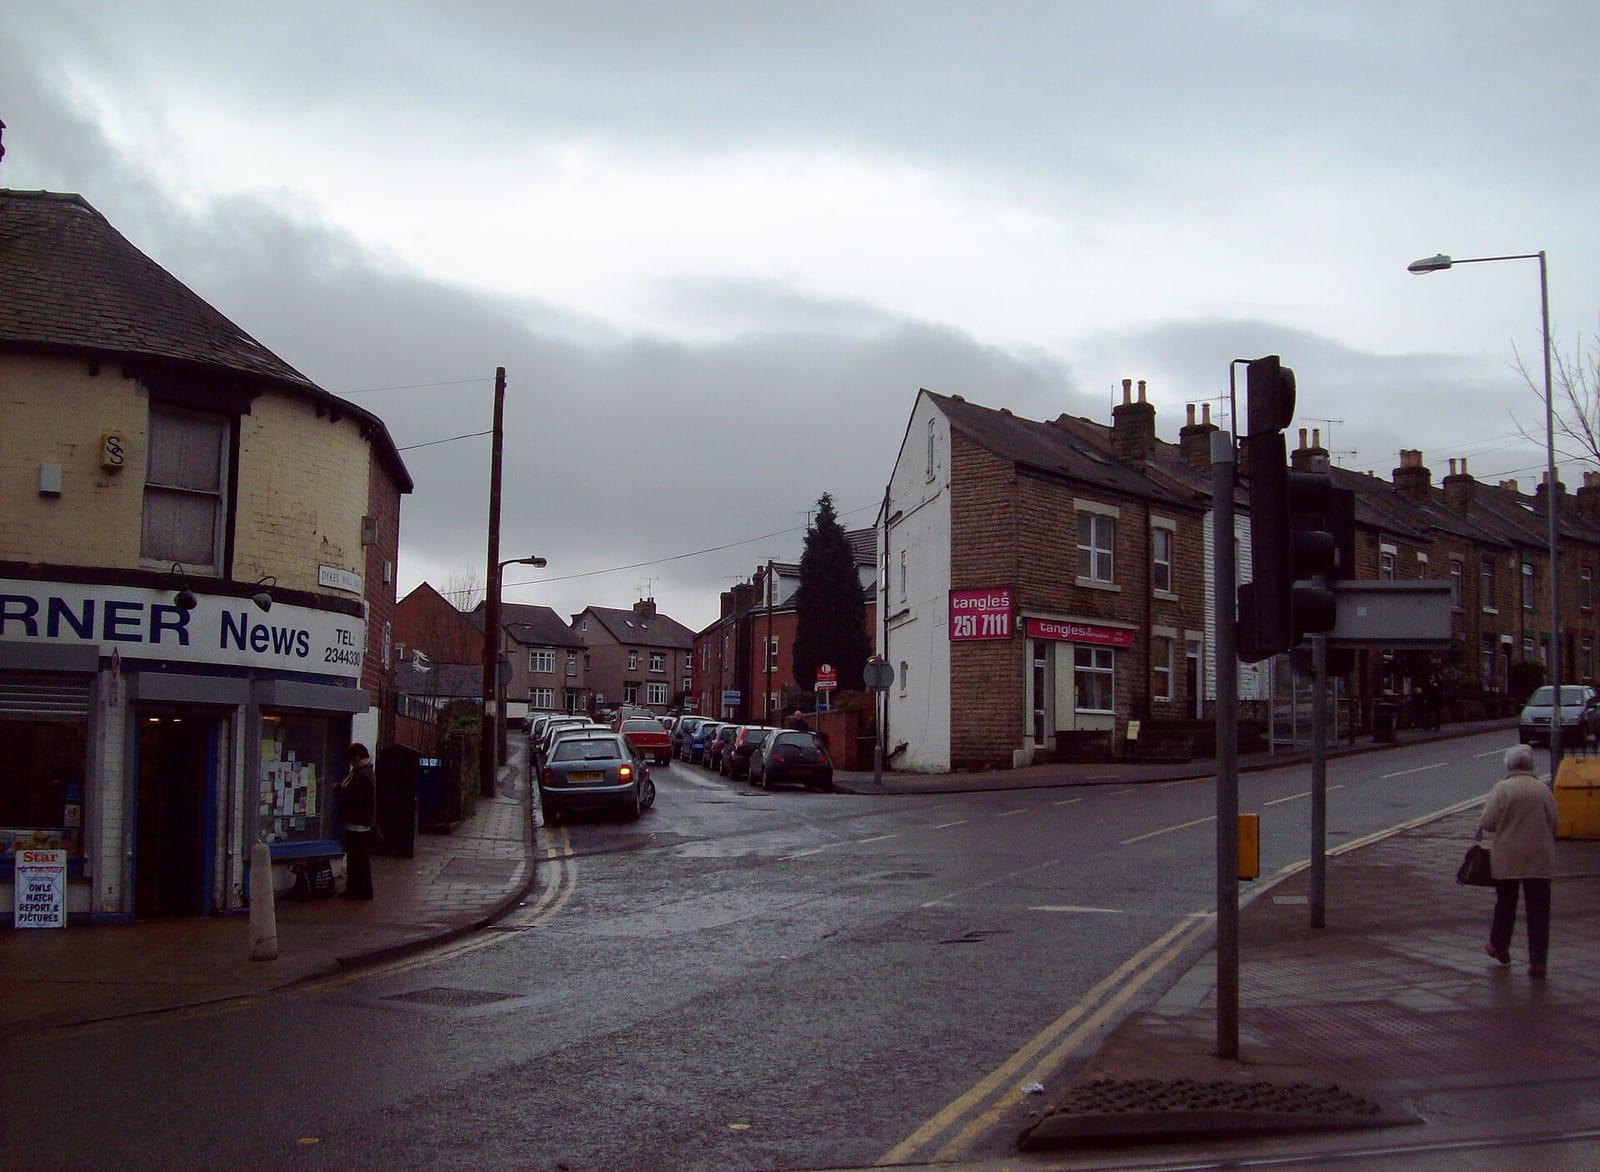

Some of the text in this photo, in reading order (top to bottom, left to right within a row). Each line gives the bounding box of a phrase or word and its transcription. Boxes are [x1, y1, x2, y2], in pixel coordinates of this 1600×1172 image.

[321, 570, 339, 584] DYKES
[953, 594, 1010, 611] tangles
[954, 613, 1008, 637] 251 7111
[1039, 622, 1085, 638] tangles
[219, 610, 310, 658] News
[336, 628, 356, 647] TEL:
[324, 647, 361, 667] 2344330
[23, 851, 59, 863] Star
[29, 884, 52, 892] OWLS
[26, 893, 54, 903] MATCH
[19, 903, 59, 912] REPORT &
[19, 913, 59, 922] PICTURES
